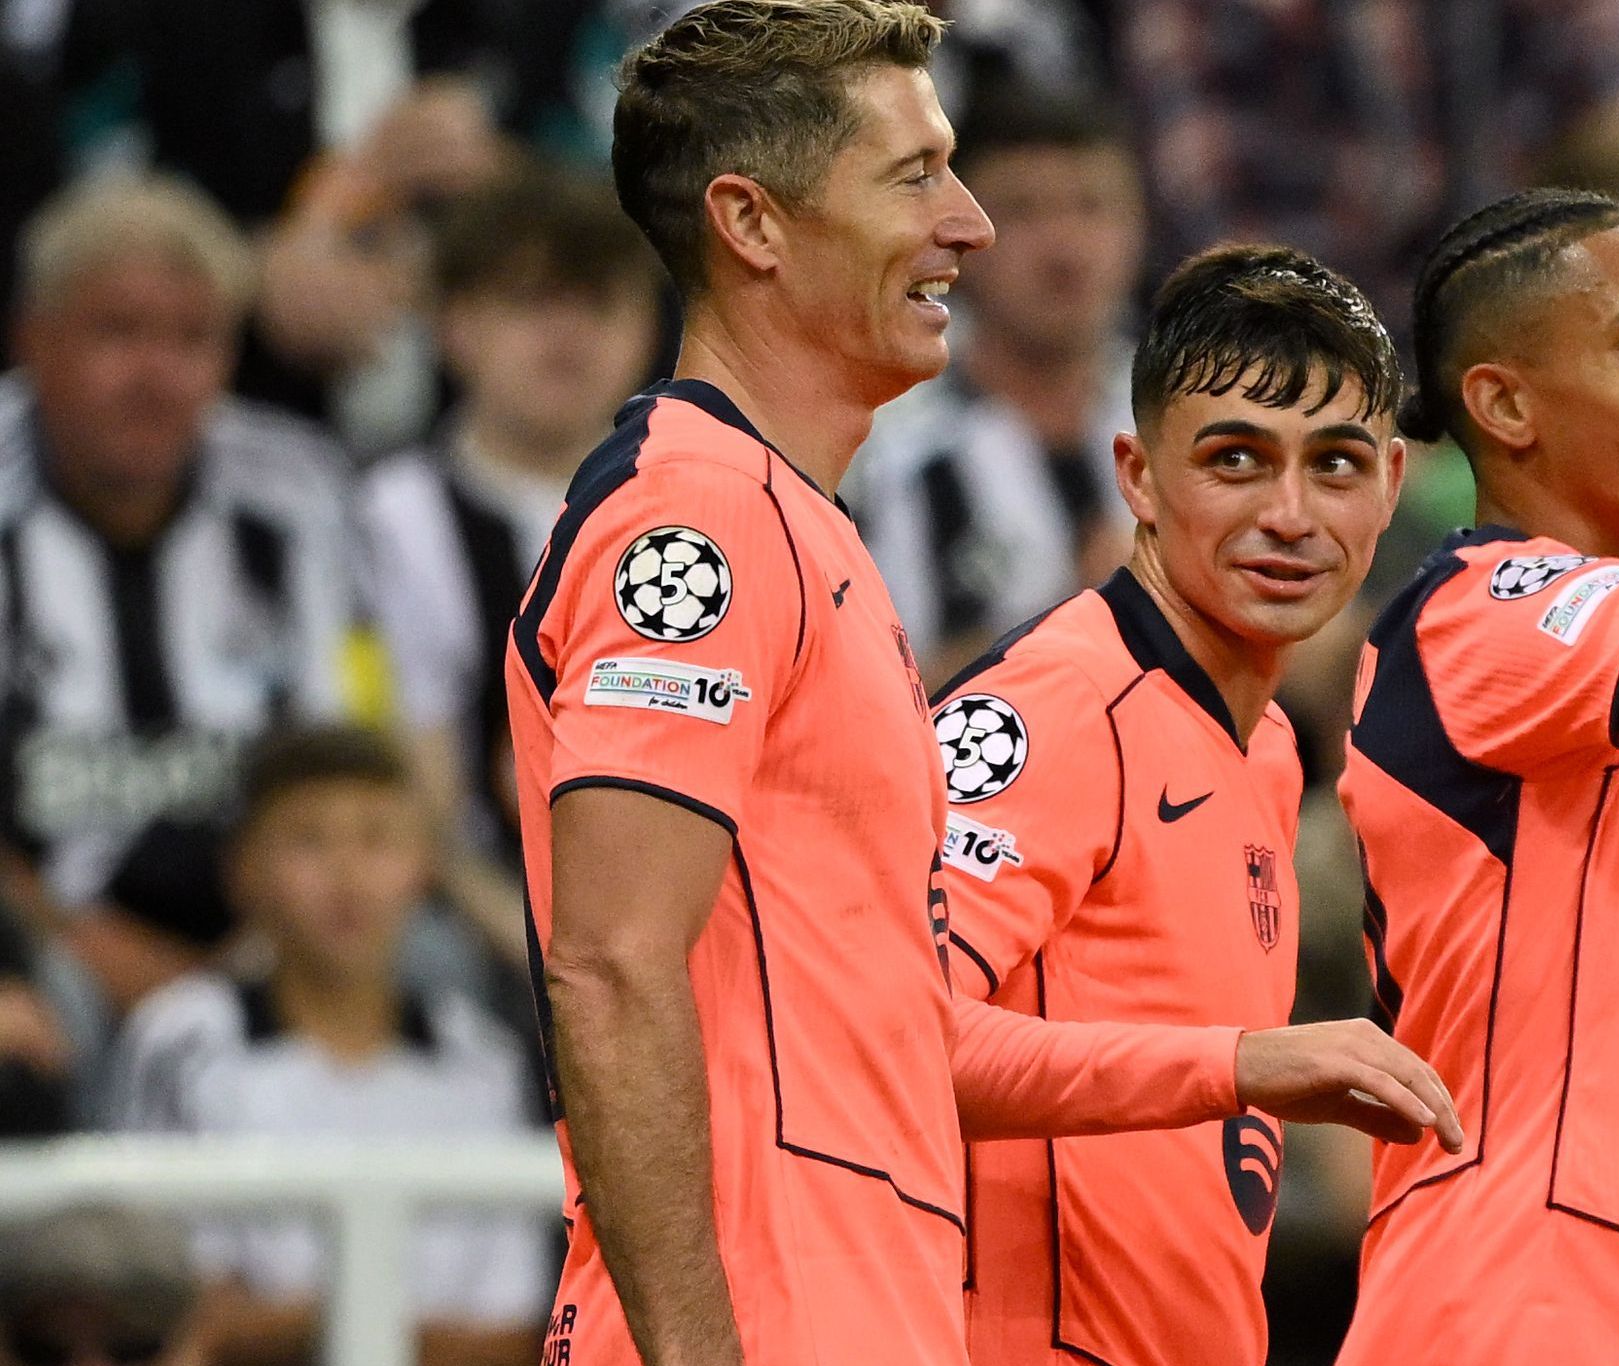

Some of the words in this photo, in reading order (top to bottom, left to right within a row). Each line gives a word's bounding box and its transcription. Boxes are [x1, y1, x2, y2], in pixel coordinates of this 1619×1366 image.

[660, 562, 688, 606] 5
[591, 675, 691, 696] FOUNDATION
[952, 726, 988, 769] 5
